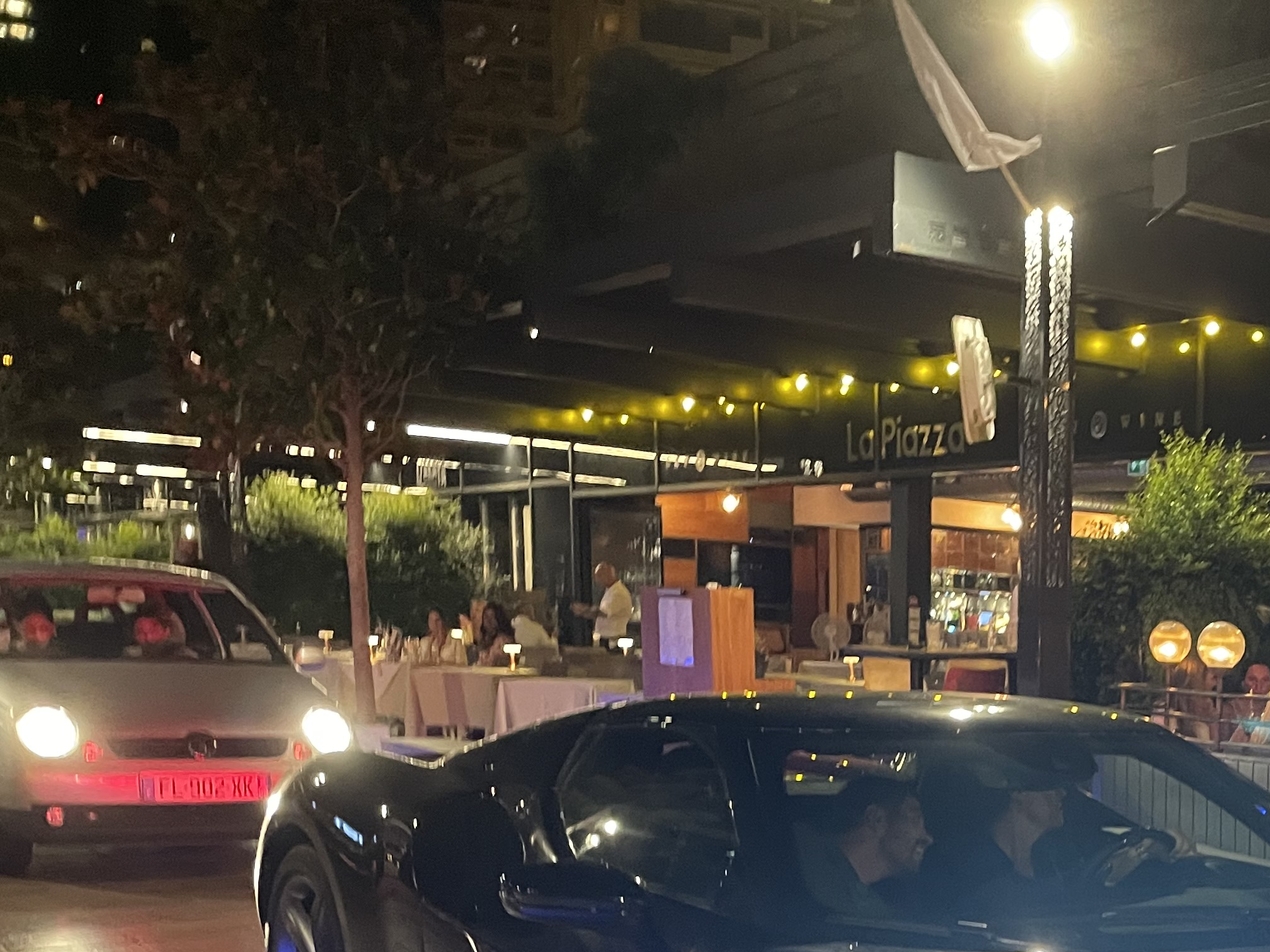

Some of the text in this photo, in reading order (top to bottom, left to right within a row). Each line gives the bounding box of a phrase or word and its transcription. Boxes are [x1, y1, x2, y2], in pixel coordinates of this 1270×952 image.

[846, 415, 965, 461] La Piazza
[232, 775, 254, 798] XK
